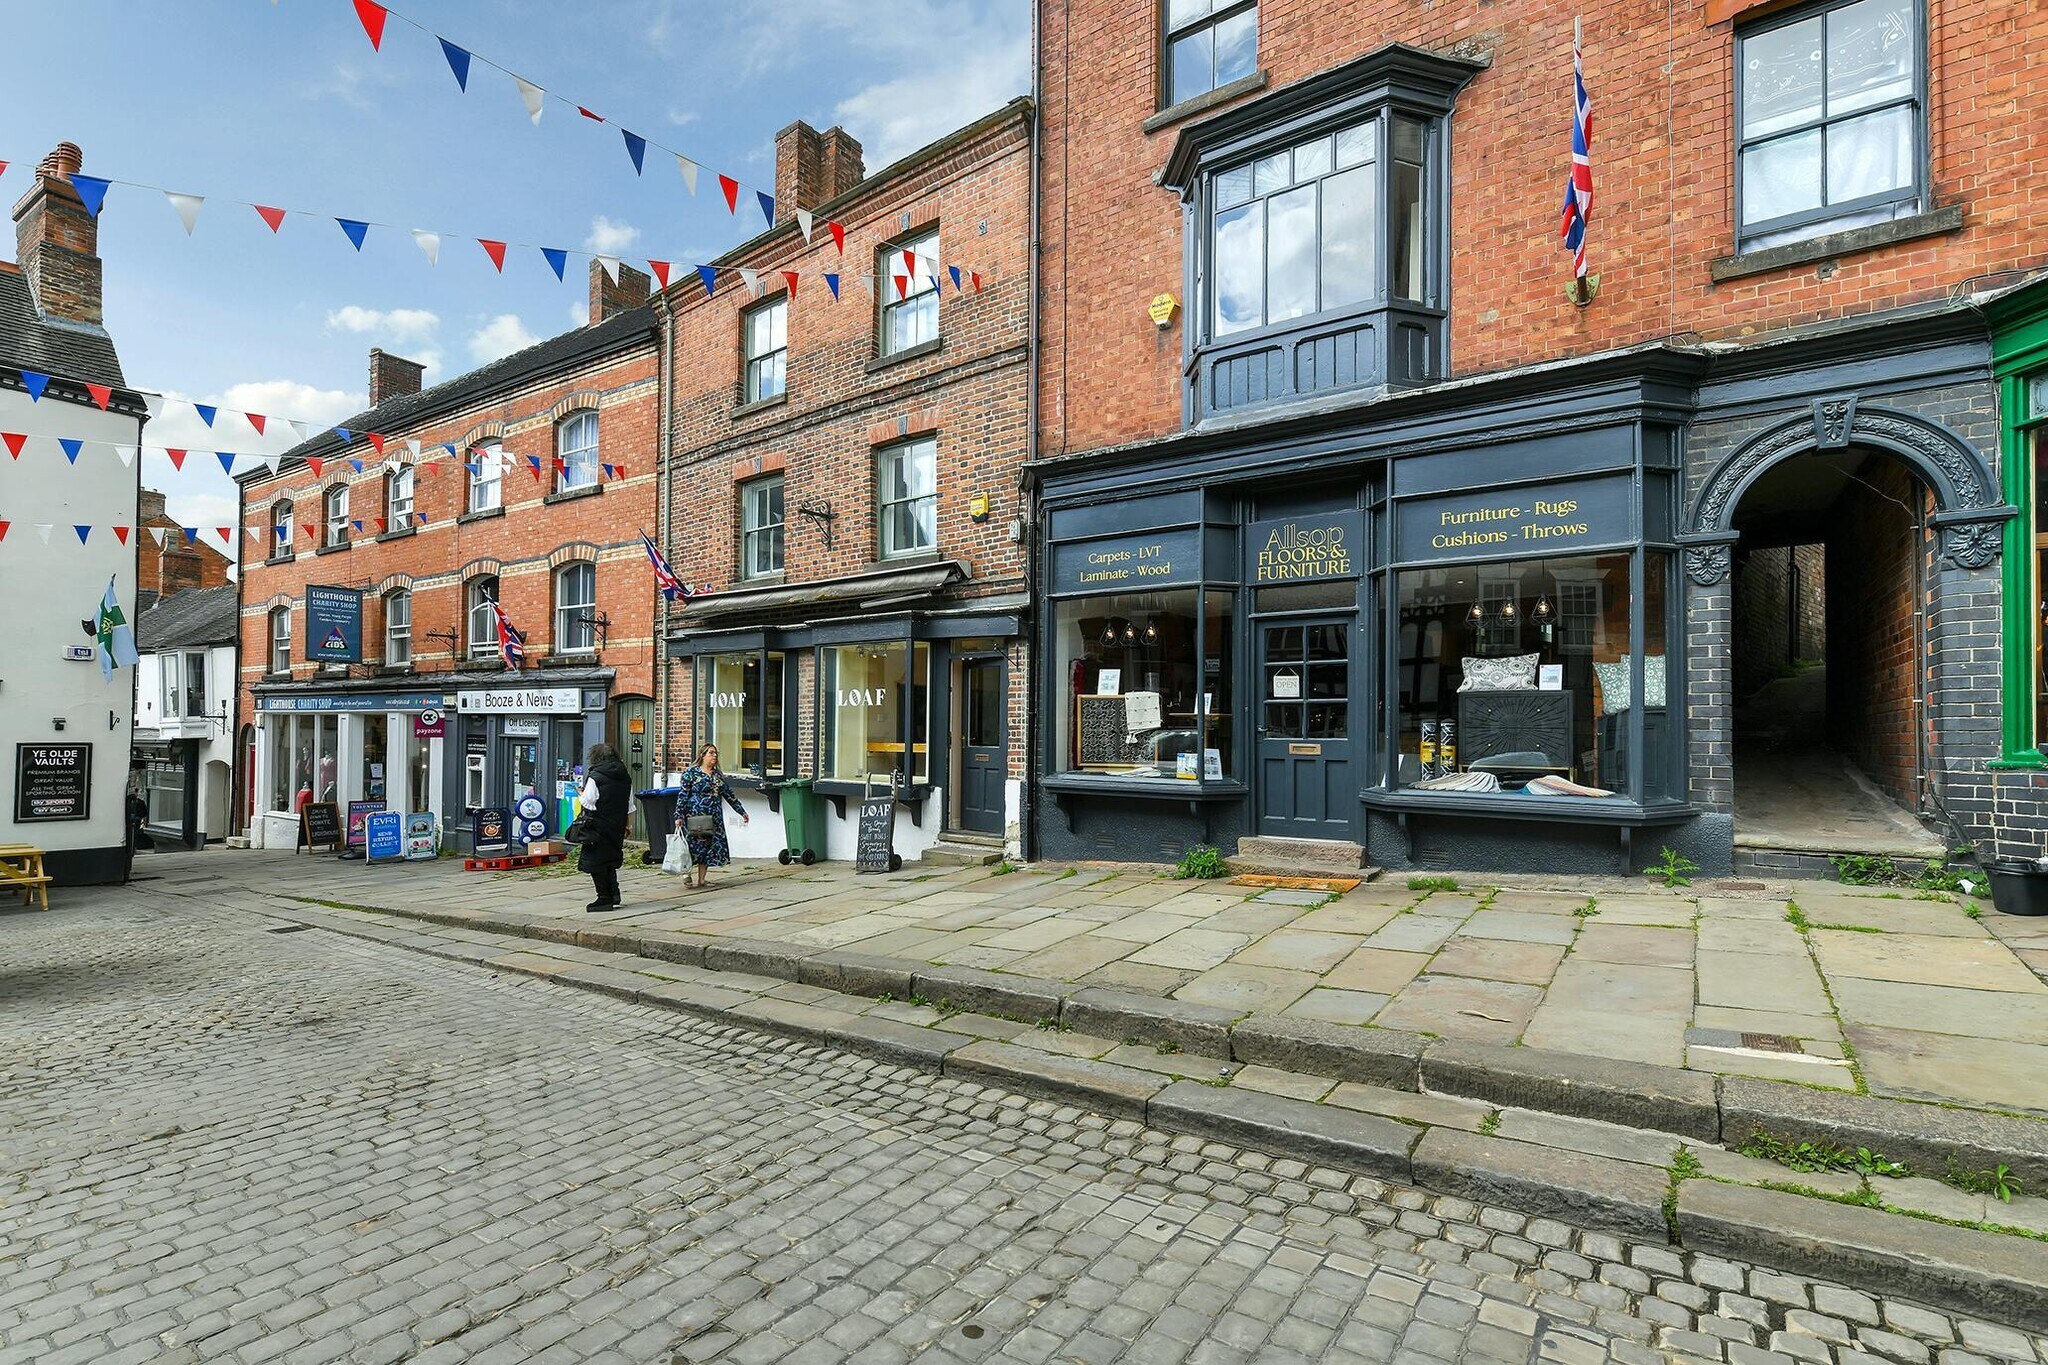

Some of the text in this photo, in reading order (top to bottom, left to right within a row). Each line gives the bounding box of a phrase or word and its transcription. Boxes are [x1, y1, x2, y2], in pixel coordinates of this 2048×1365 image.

[1441, 507, 1521, 526] Furniture
[1535, 500, 1578, 517] Rugs
[1264, 523, 1344, 552] Allsop
[1432, 530, 1508, 548] Cushions
[1521, 523, 1588, 539] Throws
[1088, 550, 1131, 565] Carpets
[1139, 545, 1162, 559] LVT
[1258, 545, 1327, 566] FLOORS
[1079, 569, 1129, 583] Laminate
[1137, 562, 1171, 576] Wood
[1257, 558, 1351, 581] FURNITURE
[312, 599, 340, 608] CHARITY
[340, 601, 357, 610] SHOP
[297, 698, 318, 709] CHARITY
[318, 698, 333, 709] SHOP
[485, 693, 514, 708] Booze
[515, 692, 523, 707] &
[526, 692, 554, 707] News
[709, 692, 747, 708] LOAF
[836, 689, 887, 707] LOAF
[509, 718, 540, 727] Off Licenc
[32, 749, 78, 758] YE OLDE
[34, 758, 75, 766] VAULTS
[861, 803, 891, 818] LOAF
